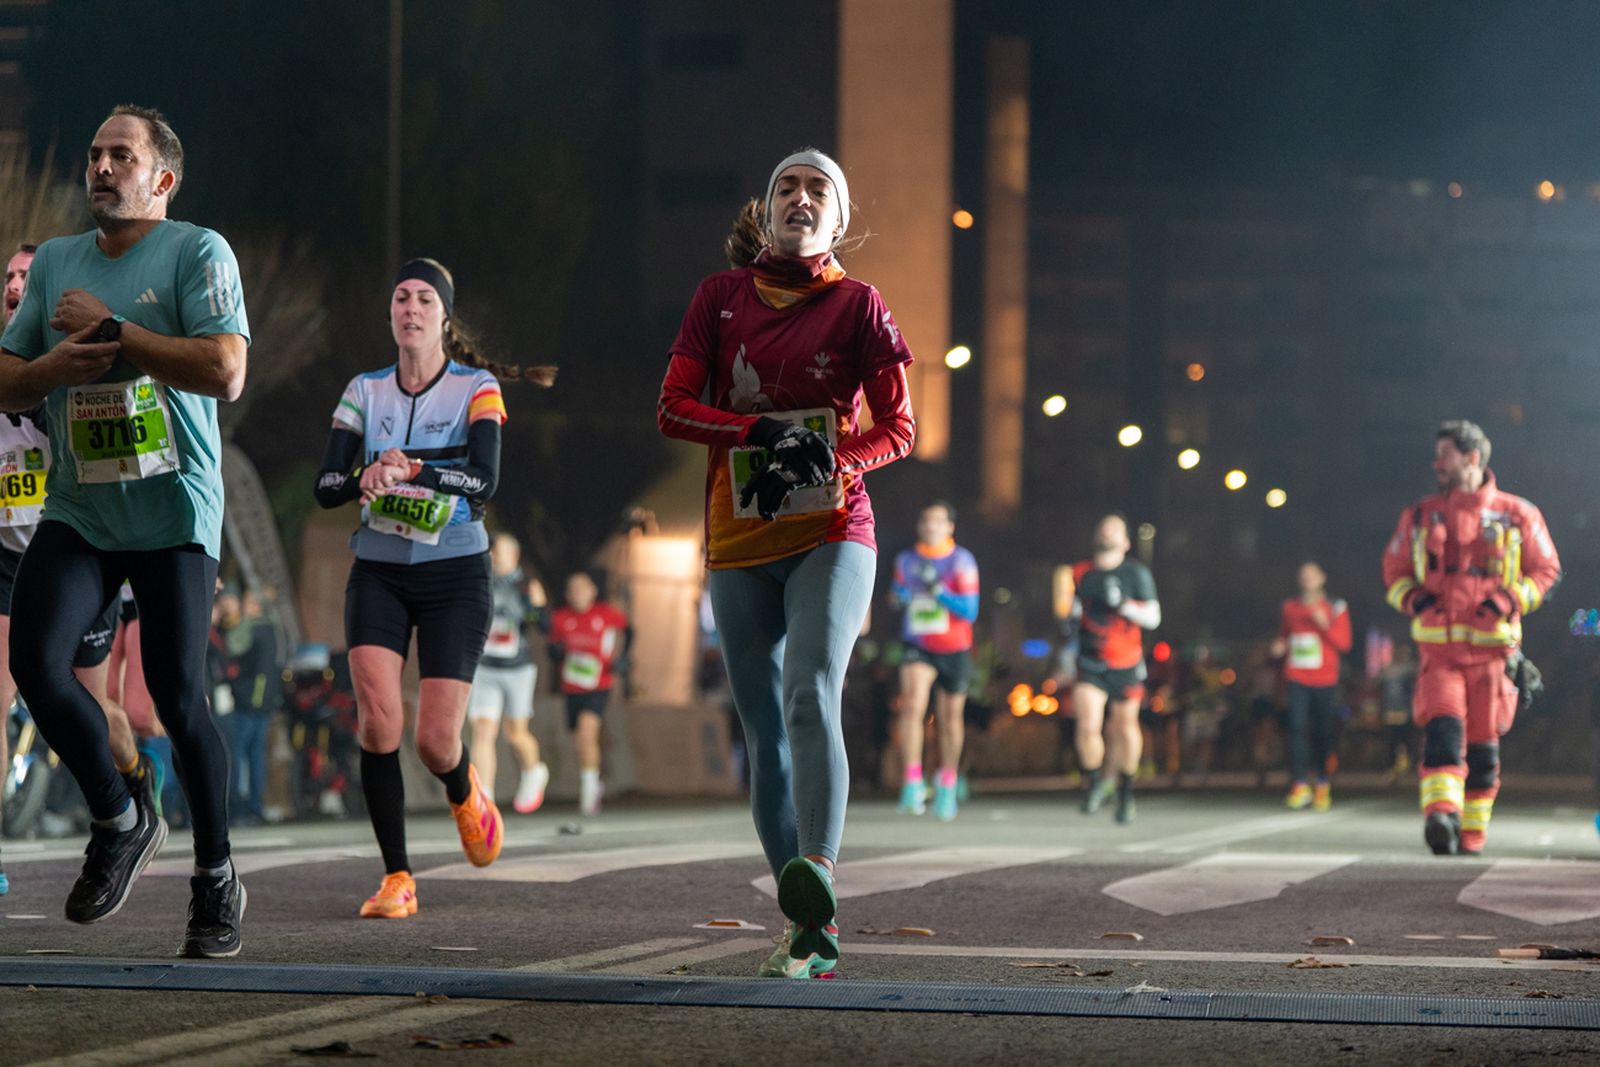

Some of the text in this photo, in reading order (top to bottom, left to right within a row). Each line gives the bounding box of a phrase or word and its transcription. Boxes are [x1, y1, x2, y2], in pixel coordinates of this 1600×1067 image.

[85, 394, 111, 406] NOCHE
[113, 393, 124, 403] DE
[76, 408, 93, 419] SAN
[88, 415, 147, 449] 3716
